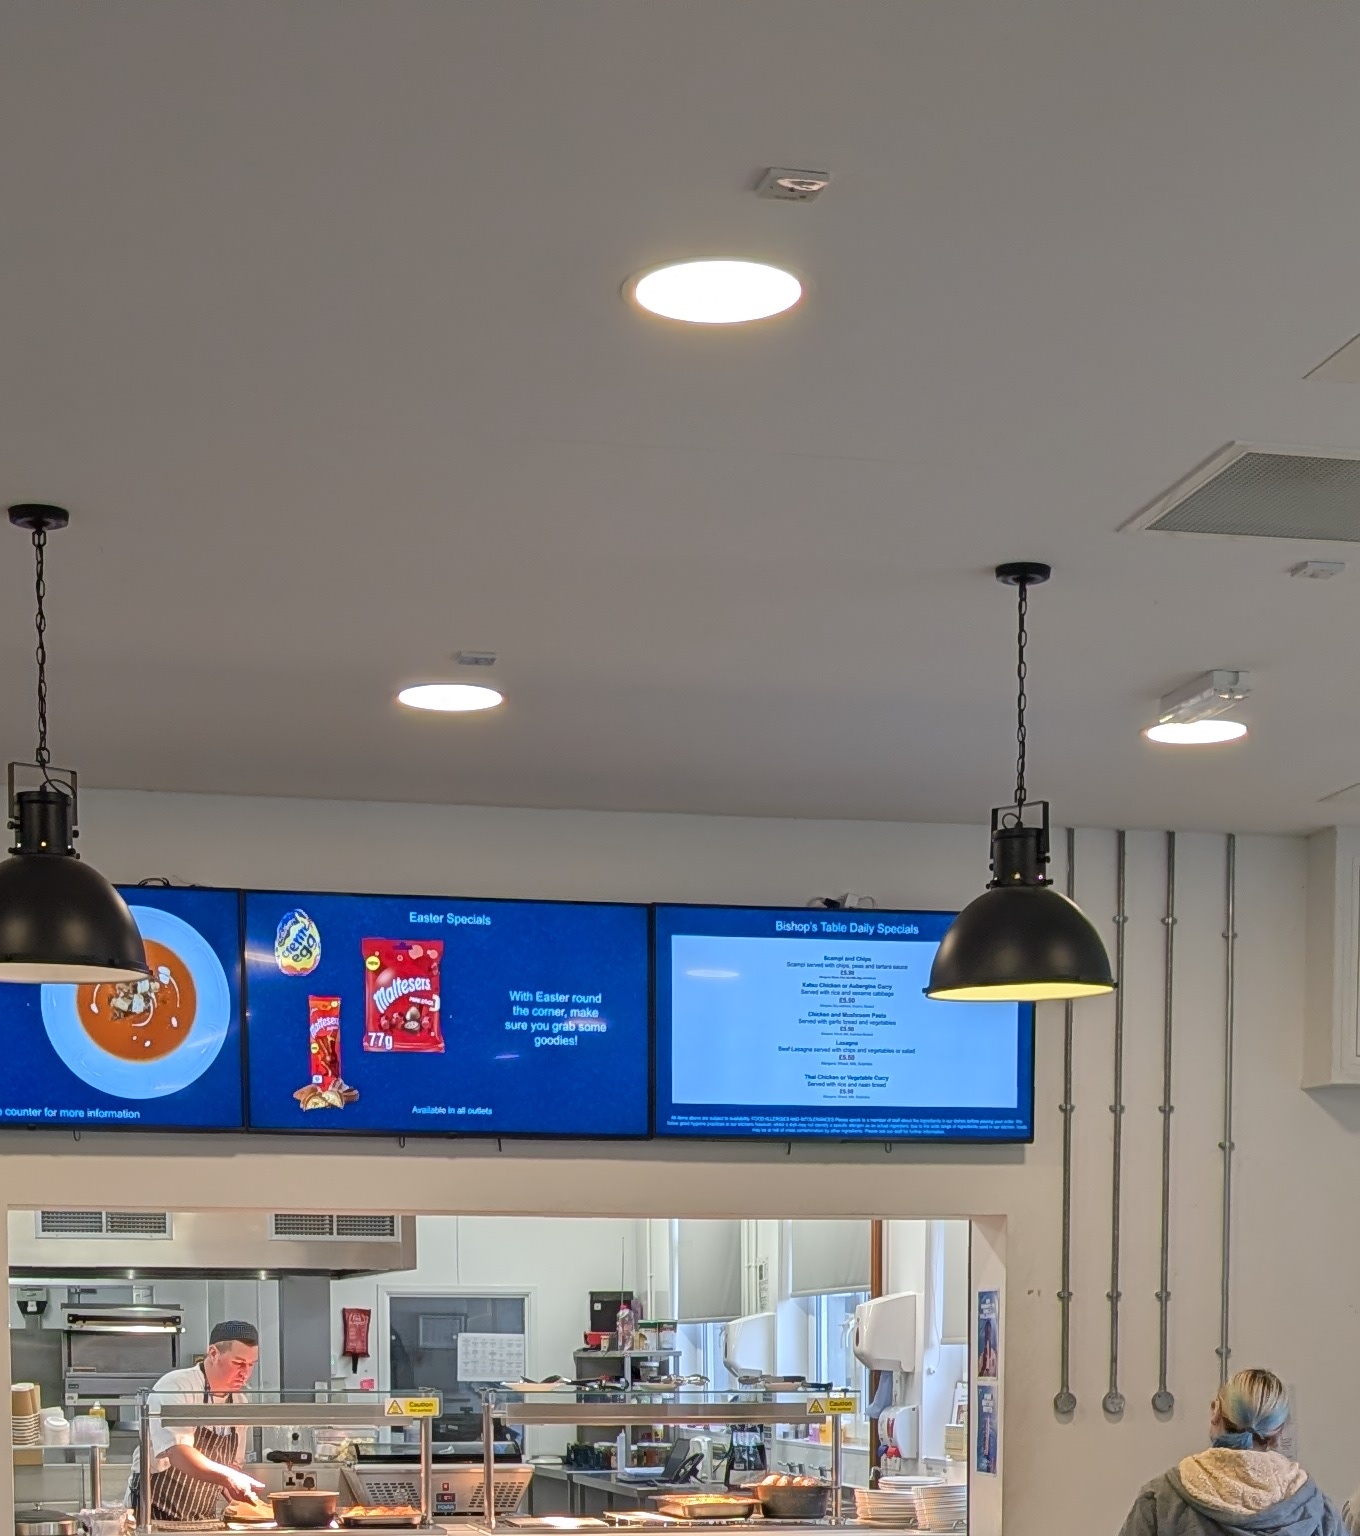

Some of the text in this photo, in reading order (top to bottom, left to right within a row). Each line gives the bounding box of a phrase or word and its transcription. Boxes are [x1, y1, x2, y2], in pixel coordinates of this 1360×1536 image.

[410, 911, 491, 926] Easter Specials
[776, 921, 919, 935] Bishop's Table Daily Specials
[373, 976, 432, 1014] Maltesers
[509, 990, 602, 1003] With Easter round
[512, 1006, 599, 1018] the corner, make
[504, 1021, 607, 1033] sure you grab some
[368, 1032, 393, 1050] 77g
[534, 1035, 578, 1048] goodies!
[5, 1107, 41, 1117] counter
[44, 1107, 57, 1117] for
[60, 1109, 84, 1118] more
[87, 1108, 140, 1119] information
[412, 1106, 492, 1115] Available in all outlets
